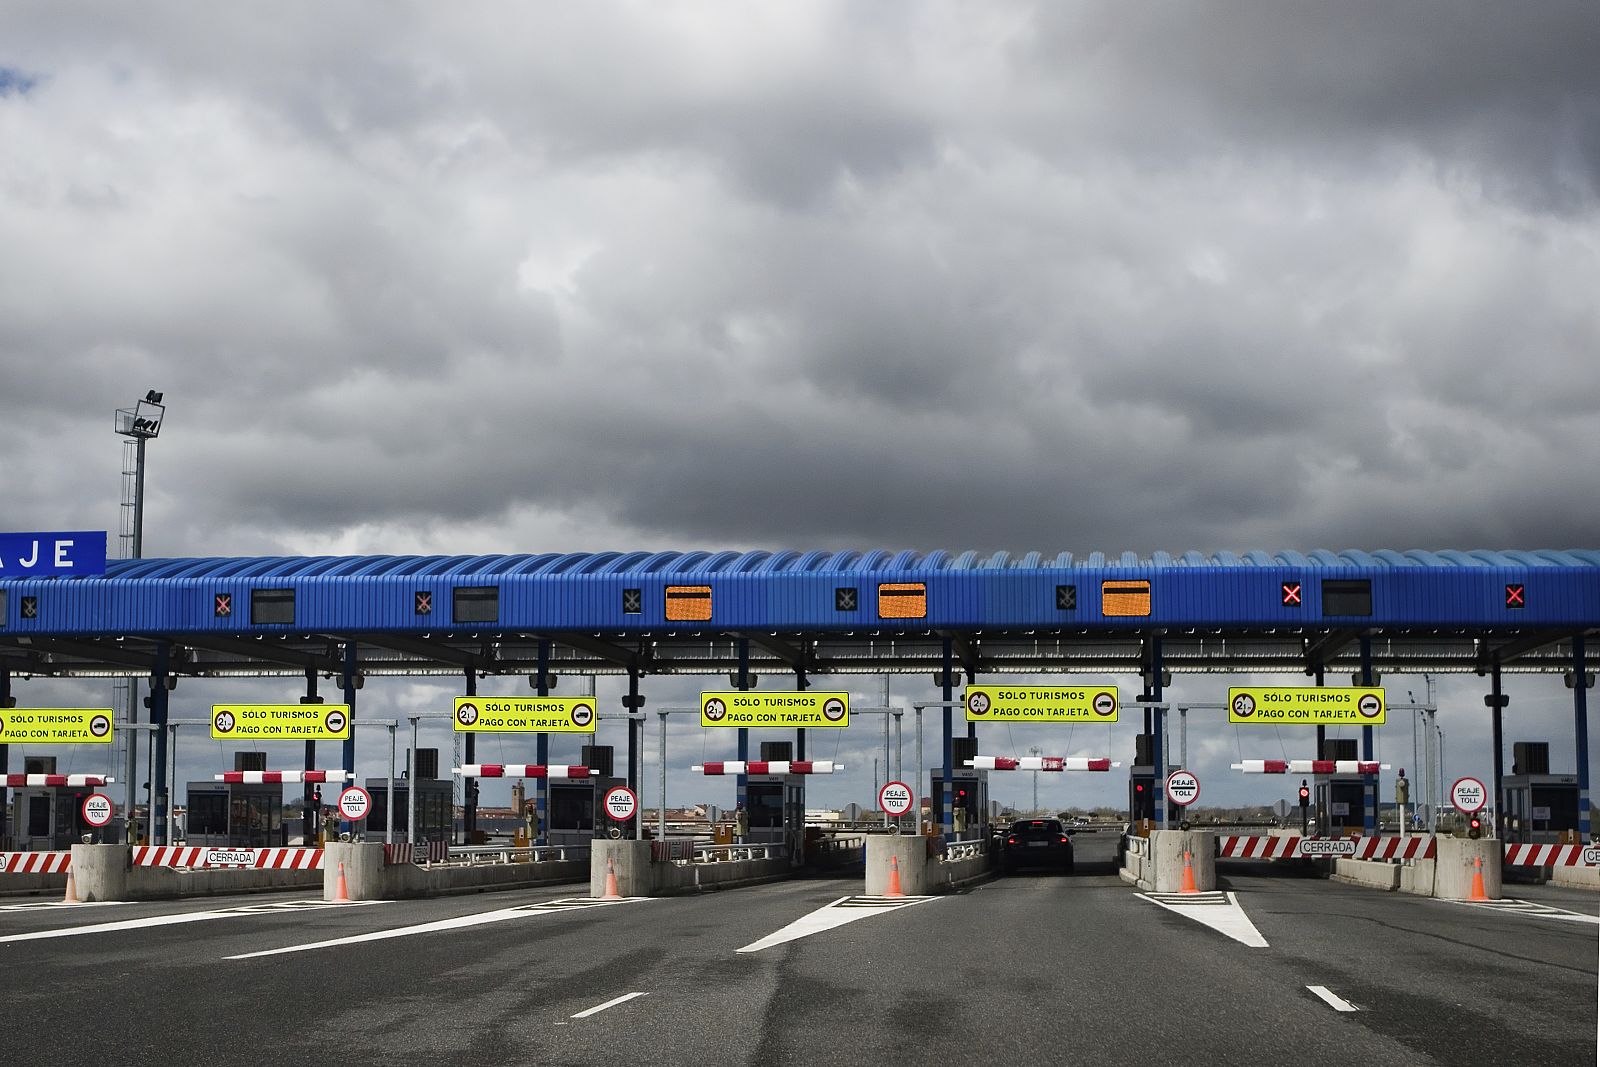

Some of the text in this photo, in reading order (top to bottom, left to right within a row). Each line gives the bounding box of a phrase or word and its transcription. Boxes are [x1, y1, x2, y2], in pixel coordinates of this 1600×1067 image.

[0, 540, 74, 568] JE
[1030, 692, 1085, 700] TURISMOS
[1263, 692, 1351, 702] SÓLO TURISMOS
[733, 697, 816, 706] SÓLO TURISMOS
[485, 702, 565, 712] SÓLO TURISMOS
[270, 711, 319, 719] TURISMOS
[993, 708, 1089, 716] PAGO CON TARJETA
[1257, 710, 1357, 718] PAGO CON TARJETA
[37, 715, 84, 723] TURISMOS
[727, 714, 822, 722] PAGO CON TARJETA
[507, 719, 527, 727] CON
[530, 719, 570, 727] TARJETA
[5, 730, 28, 738] PAGO
[52, 730, 88, 738] TARJETA
[236, 726, 324, 734] PAGO CON TARJETA
[1303, 842, 1353, 853] CERRADA
[209, 852, 252, 863] CERRADA
